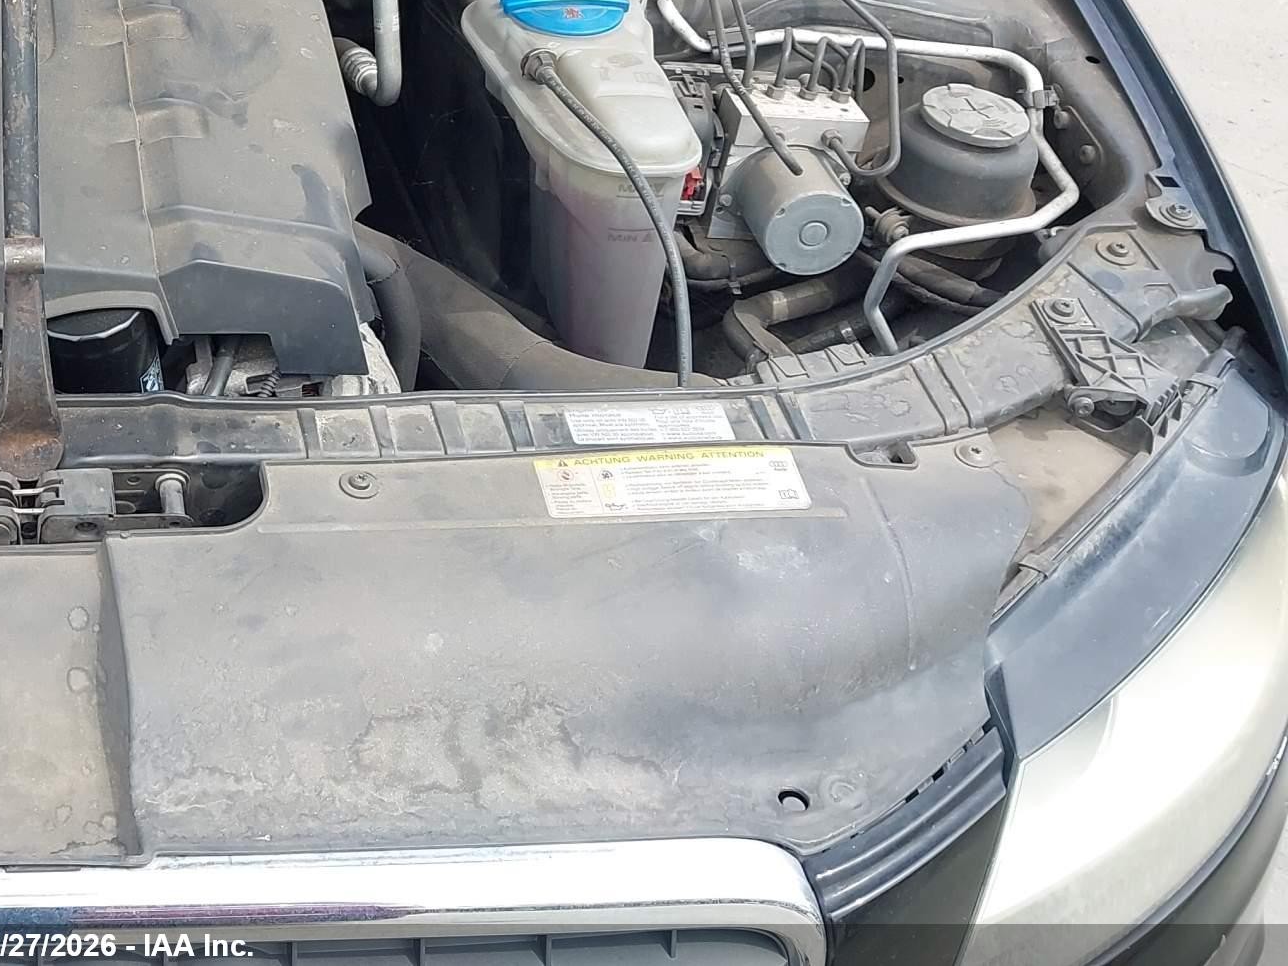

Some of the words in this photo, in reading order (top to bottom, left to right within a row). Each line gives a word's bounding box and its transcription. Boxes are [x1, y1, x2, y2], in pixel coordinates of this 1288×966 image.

[574, 455, 631, 466] ACHTUNG
[636, 452, 695, 462] WARNING
[701, 450, 765, 459] ATTENTION
